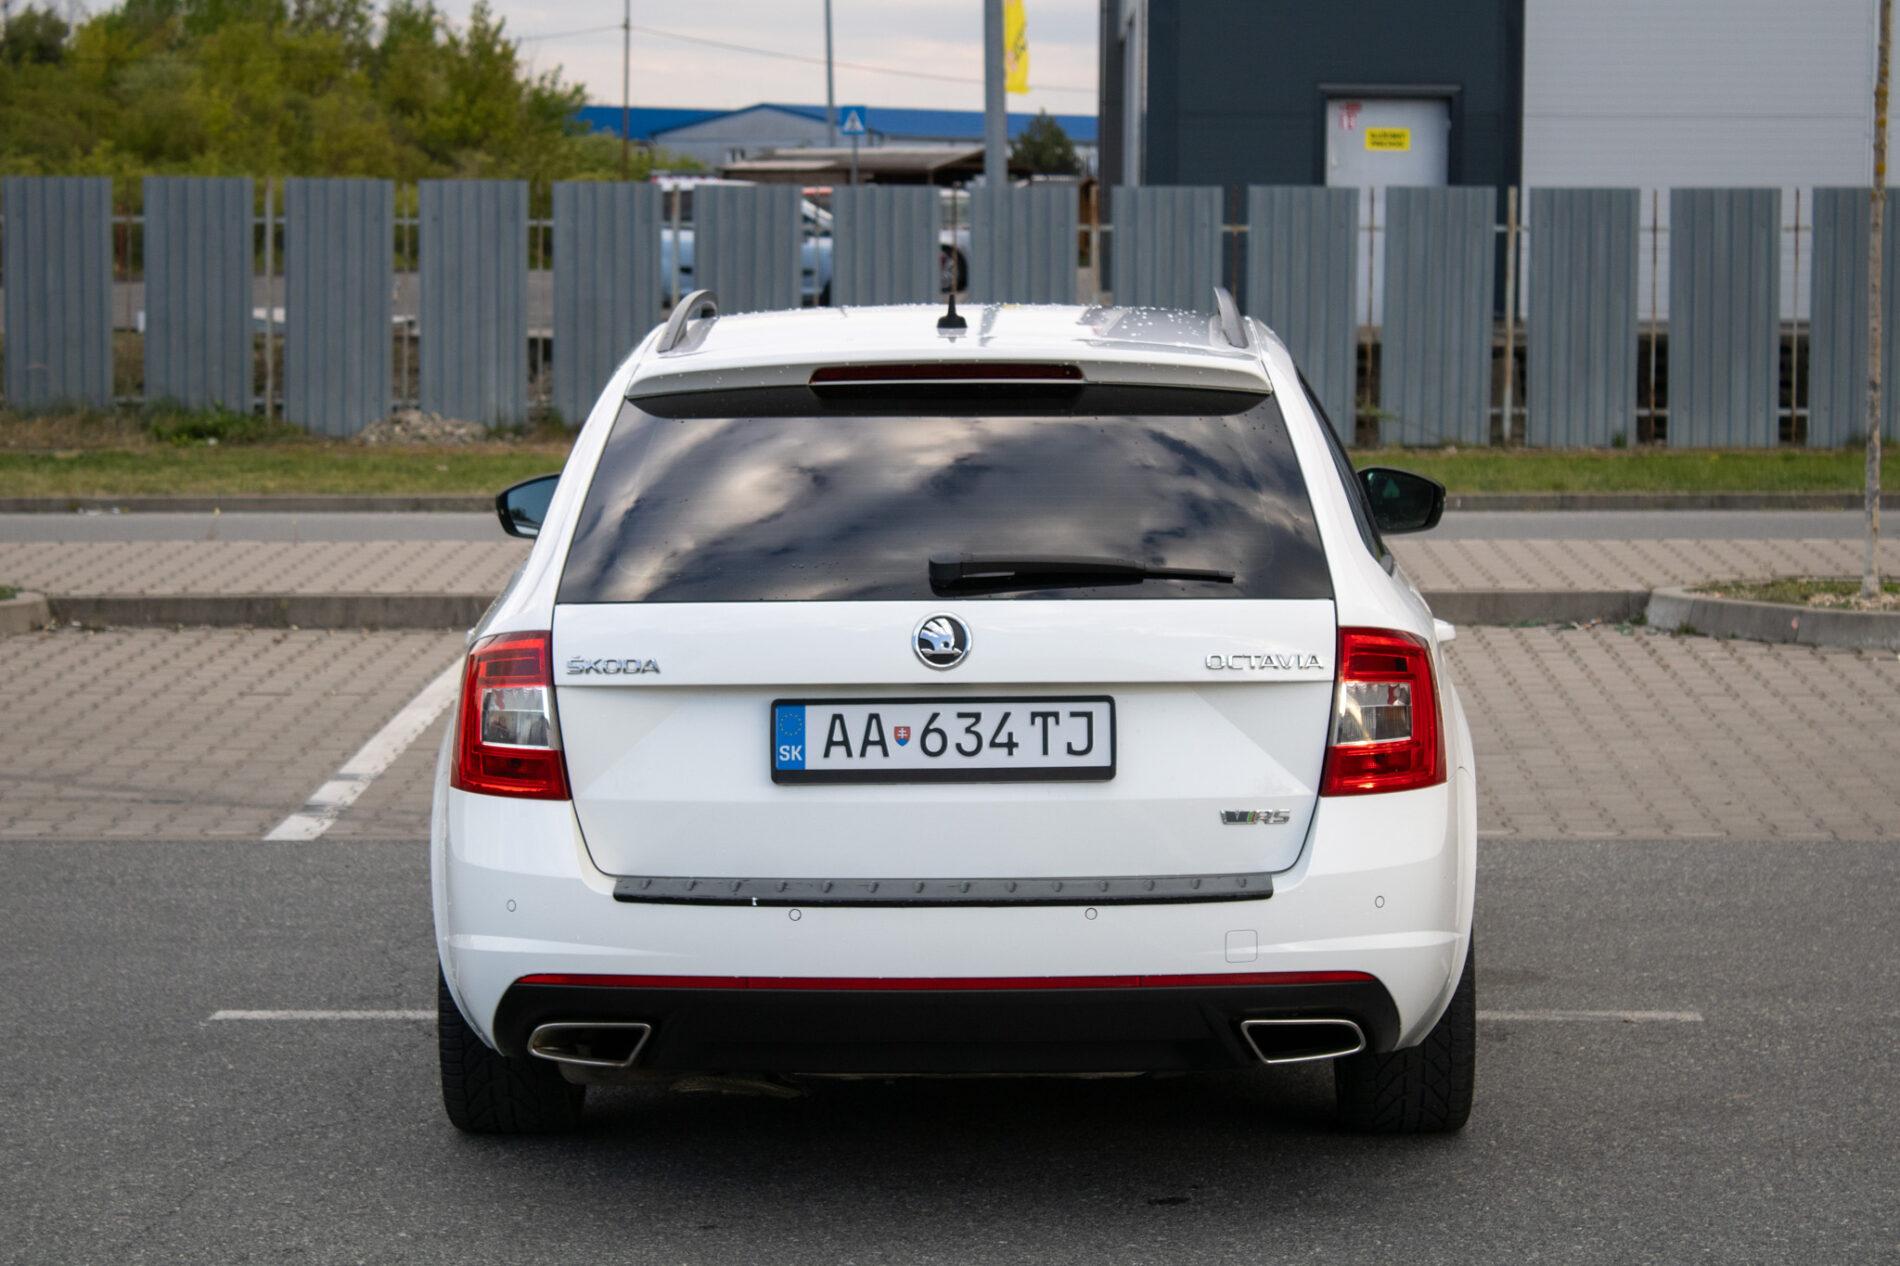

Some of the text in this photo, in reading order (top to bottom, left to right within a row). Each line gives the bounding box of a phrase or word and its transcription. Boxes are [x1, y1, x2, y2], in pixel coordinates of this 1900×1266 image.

[1205, 654, 1324, 671] OCTAVIA
[823, 711, 1095, 759] AA 634TJ
[779, 745, 803, 761] SK
